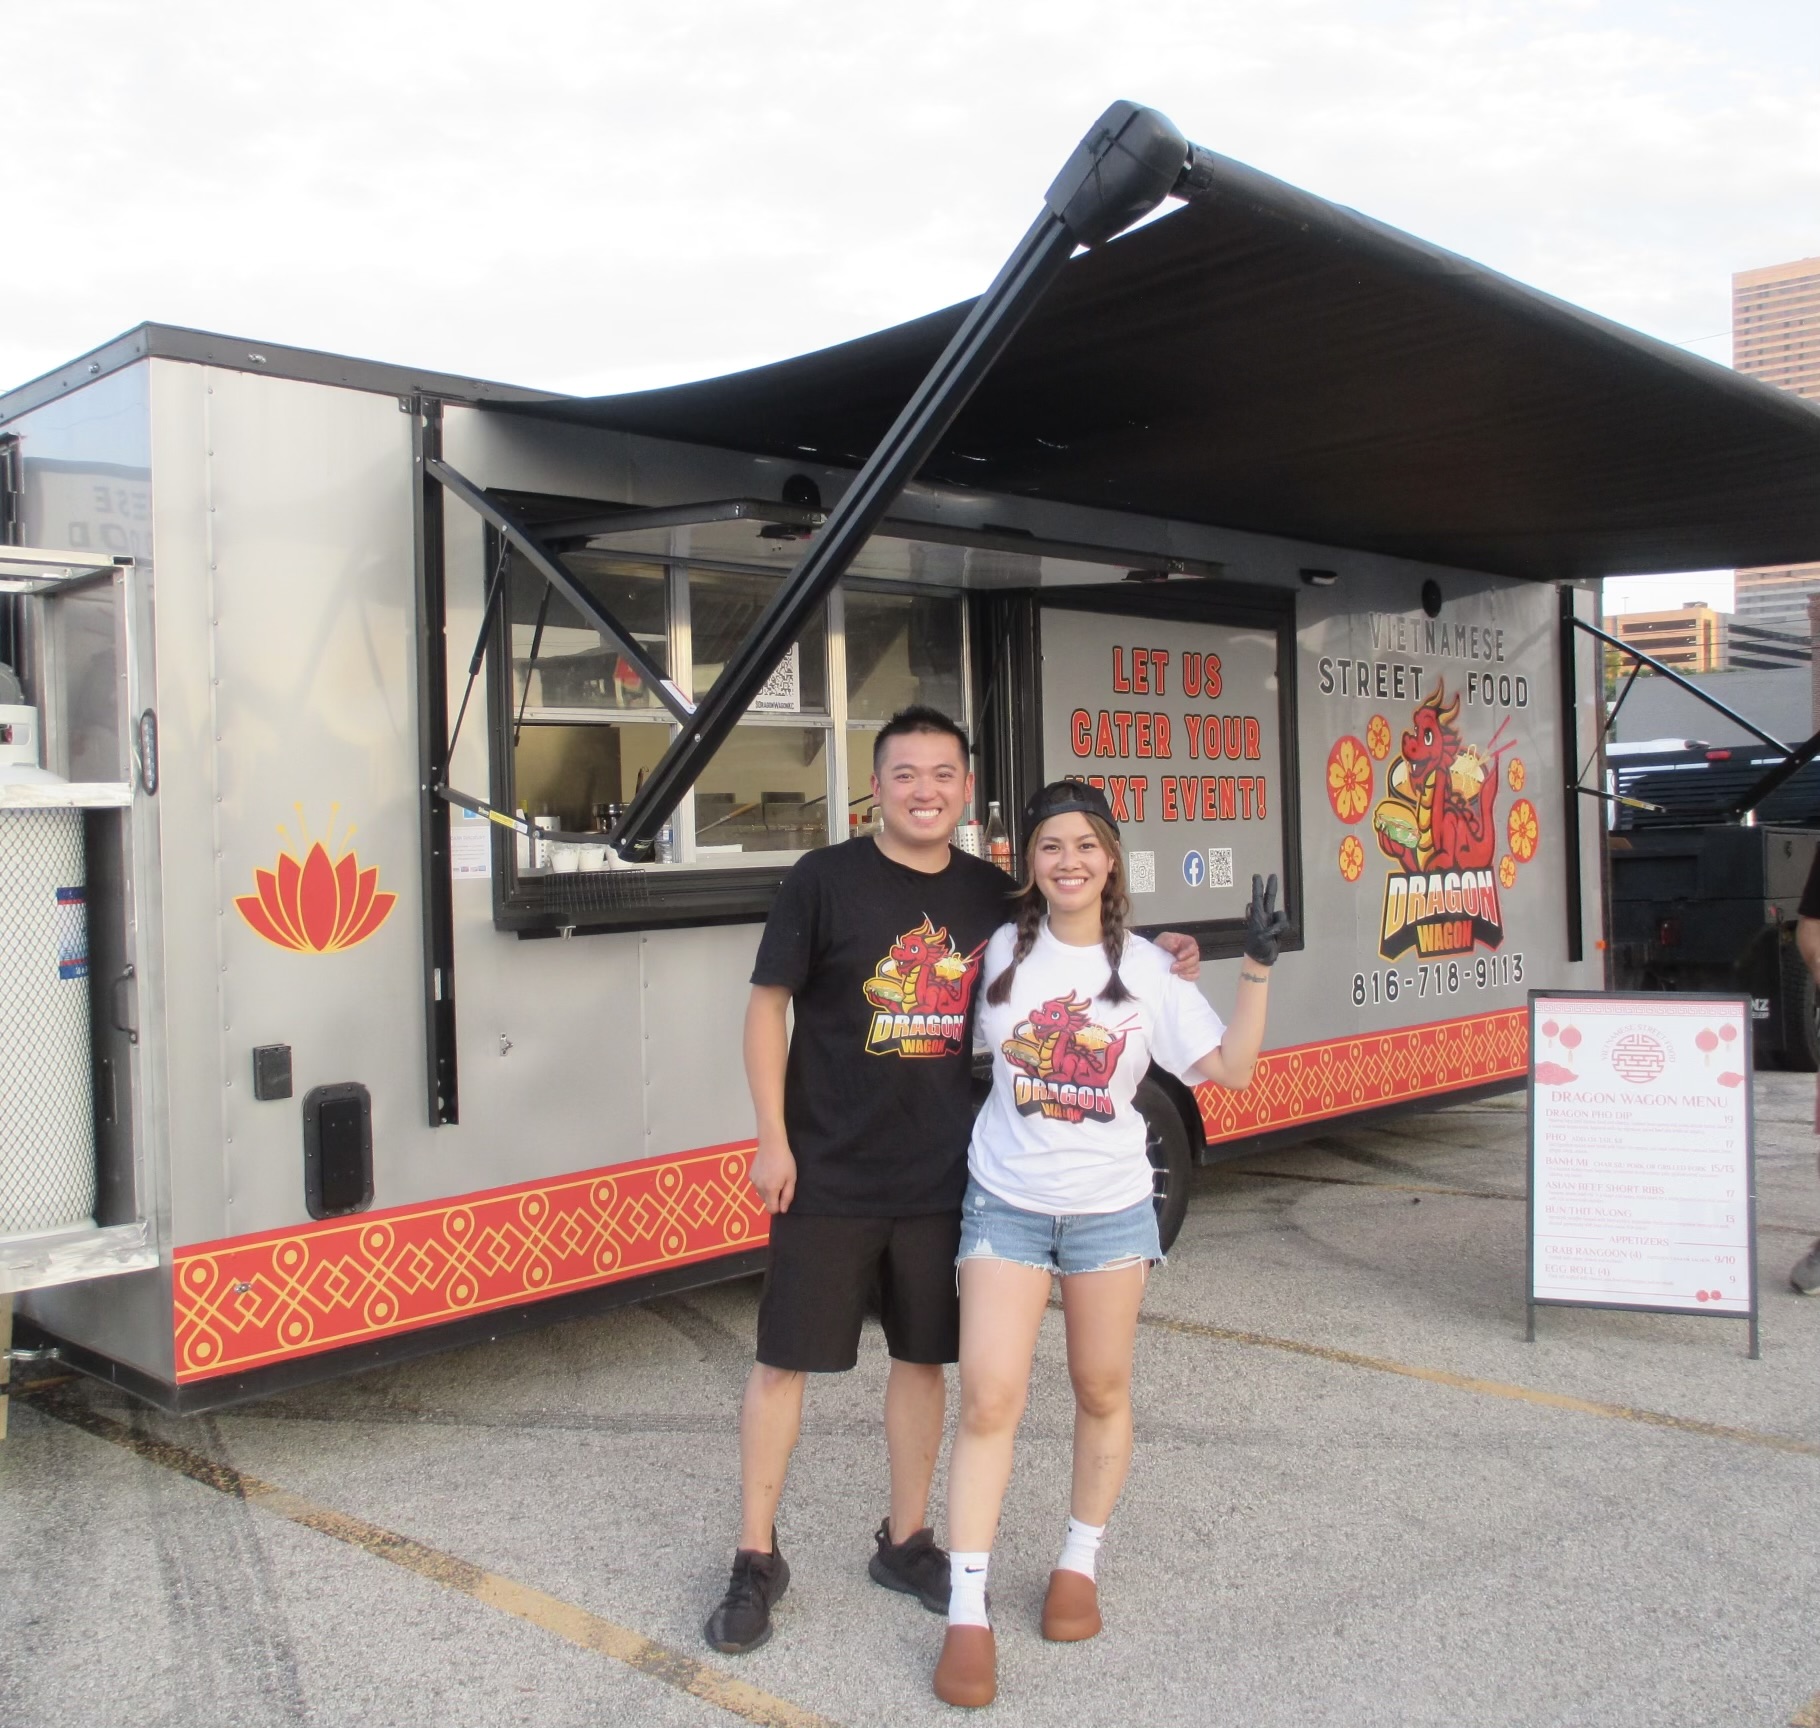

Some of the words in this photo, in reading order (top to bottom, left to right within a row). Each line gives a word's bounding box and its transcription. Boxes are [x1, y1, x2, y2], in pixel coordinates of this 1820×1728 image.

[1369, 611, 1505, 663] VIETNAMESE
[1112, 646, 1169, 694] LET
[1182, 652, 1223, 698] US
[1318, 656, 1424, 701] STREET
[1466, 670, 1529, 708] FOOD
[1070, 708, 1172, 759] CATER
[1184, 713, 1261, 760] YOUR
[1064, 774, 1148, 822] XT
[1161, 775, 1267, 822] EVENT!
[1384, 870, 1499, 940] DRAGON
[1416, 920, 1473, 953] WAGON
[1351, 953, 1524, 1007] 816-718-9113
[871, 1013, 964, 1044] DRAGON
[1637, 1024, 1667, 1040] STREET
[1664, 1040, 1676, 1063] FOOD
[901, 1038, 947, 1054] WAGON
[1015, 1076, 1112, 1115] DRAGON
[1551, 1091, 1616, 1104] DRAGON
[1620, 1093, 1678, 1106] WAGON
[1682, 1095, 1728, 1108] MENU
[1546, 1109, 1589, 1118] DRAGON
[1591, 1110, 1613, 1119] PHO
[1615, 1111, 1633, 1120] DIP
[1546, 1133, 1567, 1142] PHO
[1546, 1157, 1573, 1167] BANH
[1576, 1158, 1589, 1167] MI
[1545, 1181, 1576, 1190] ASIAN
[1578, 1182, 1604, 1191] BEEF
[1605, 1183, 1640, 1193] SHORT
[1642, 1185, 1665, 1195] RIBS
[1545, 1205, 1566, 1214] BUN
[1568, 1206, 1591, 1215] THIT
[1594, 1207, 1632, 1217] NUONG
[1545, 1245, 1573, 1255] CRAB
[1575, 1247, 1627, 1258] RANGOON
[1714, 1255, 1736, 1265] 9/10
[1609, 1235, 1670, 1246] APPETIZERS
[1545, 1263, 1567, 1273] EGG
[1569, 1265, 1596, 1275] ROLL
[1729, 1275, 1736, 1284] 9
